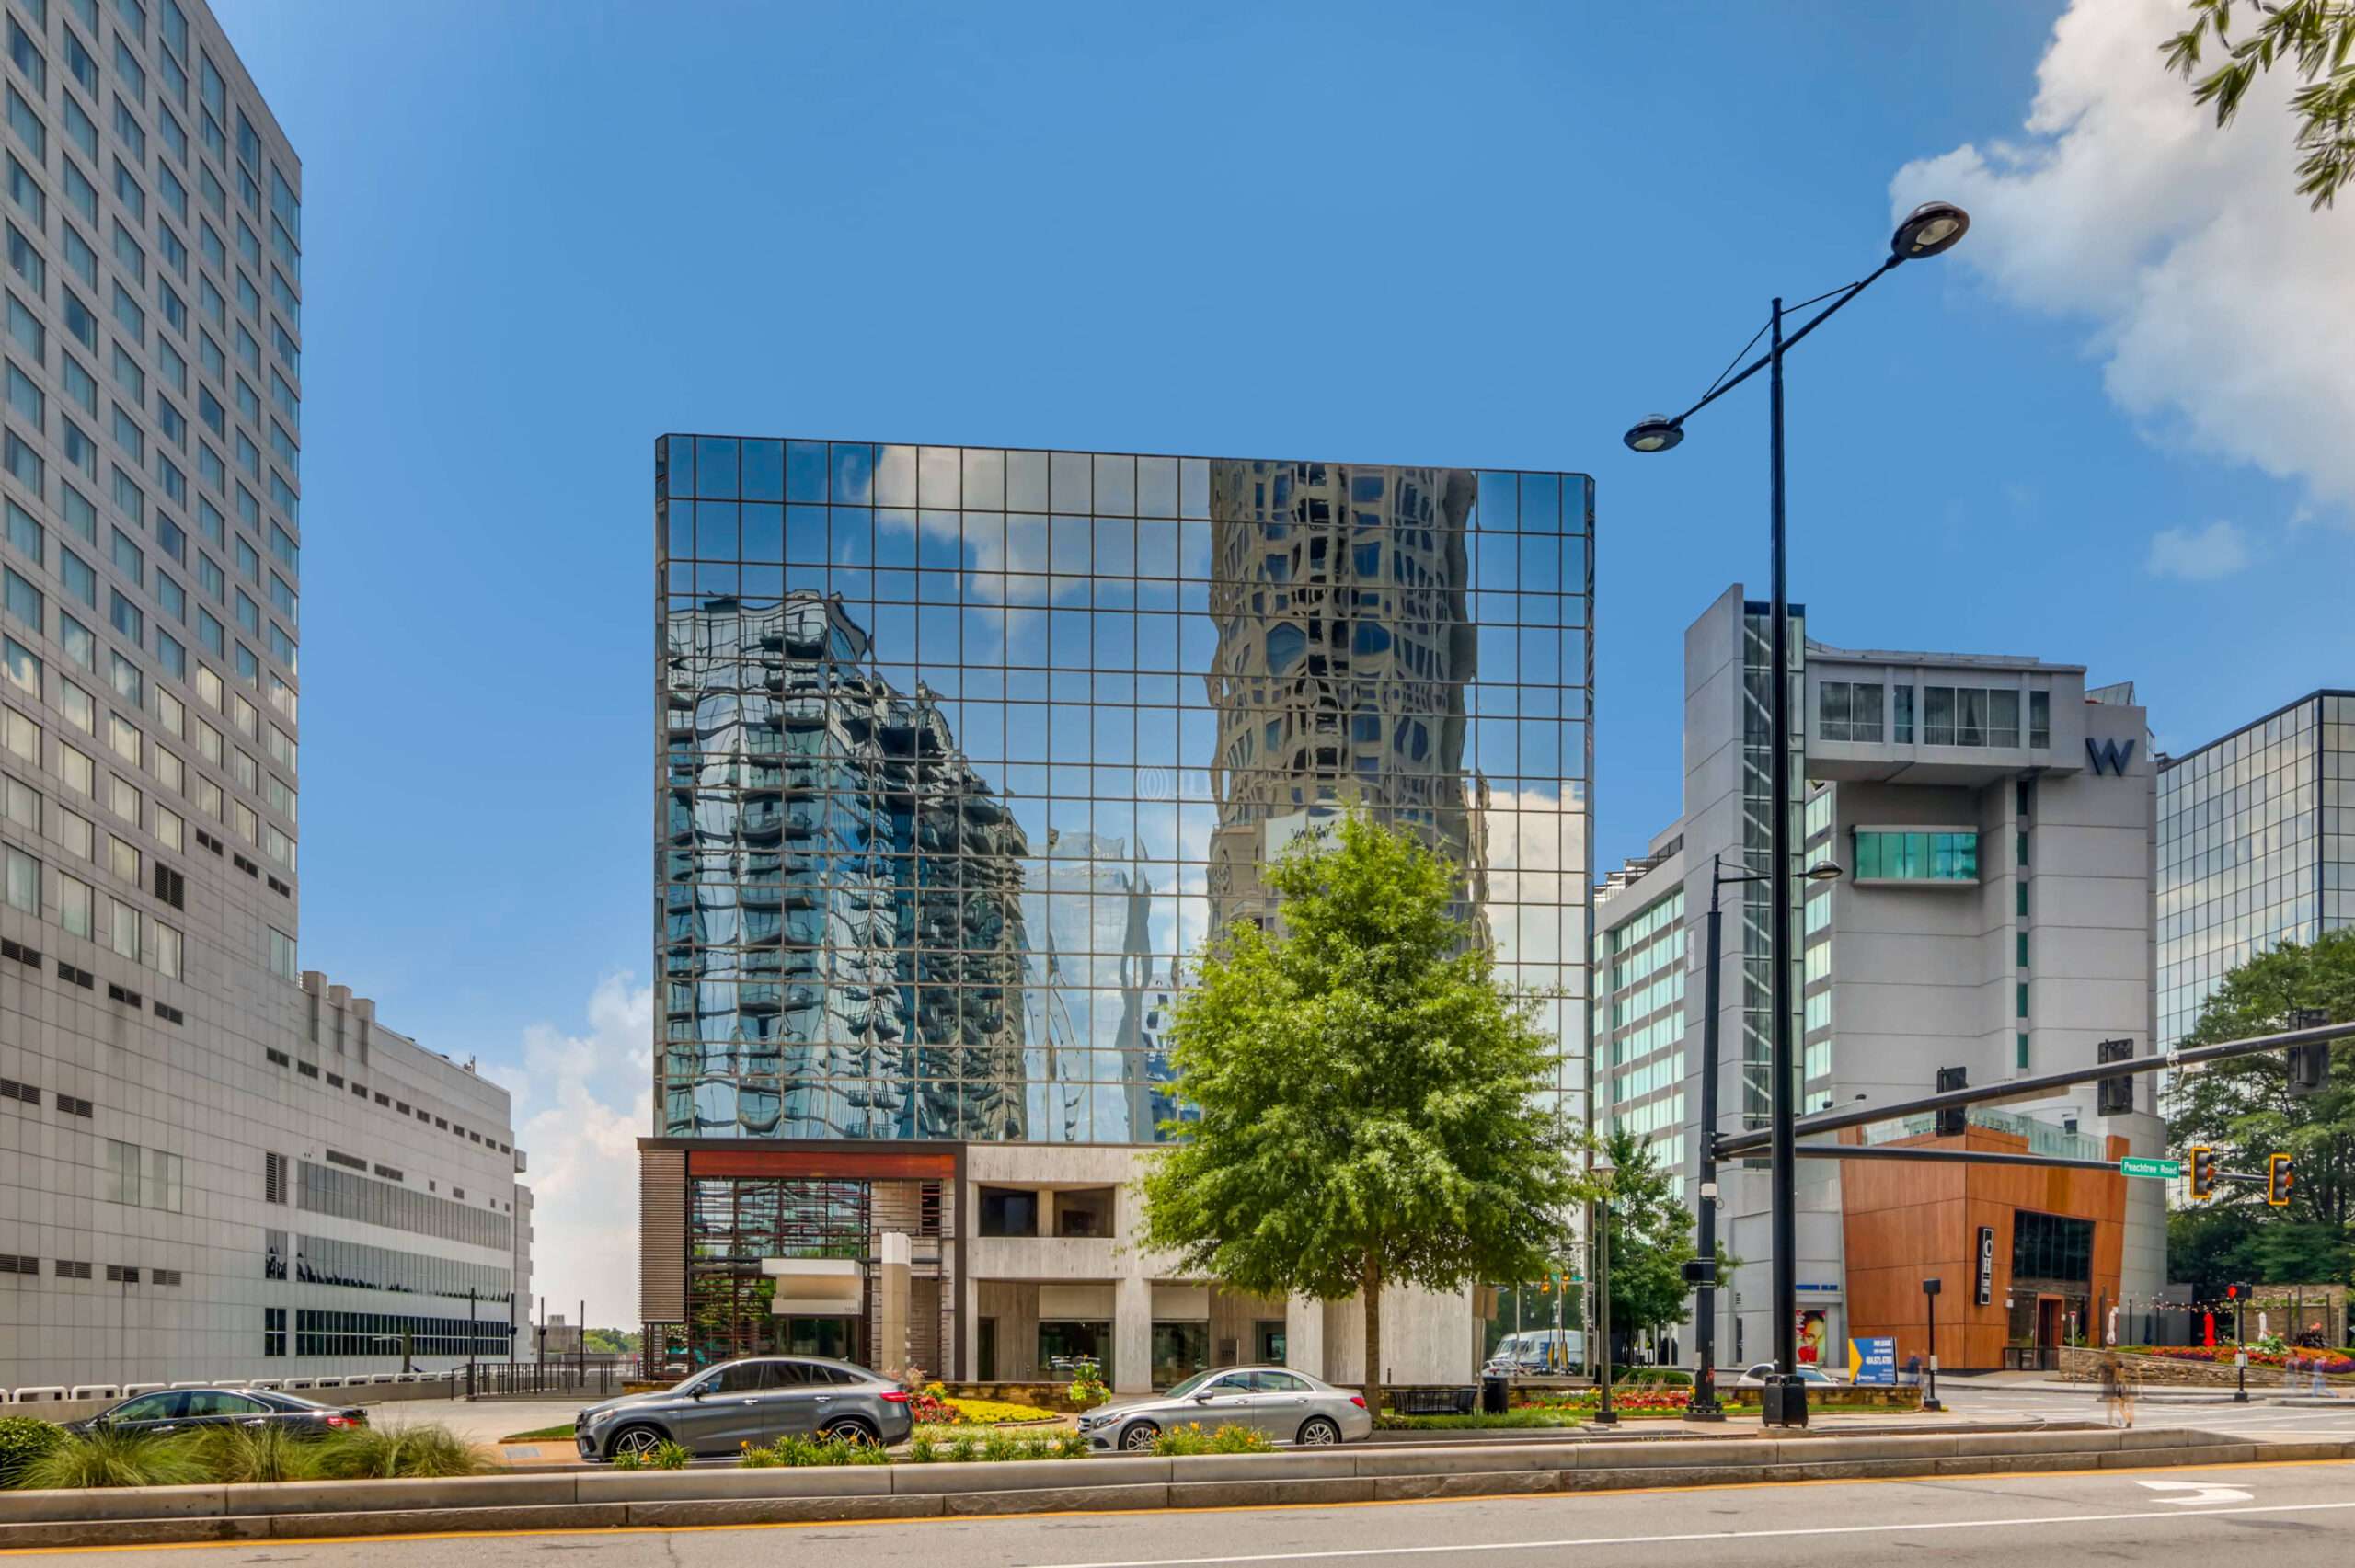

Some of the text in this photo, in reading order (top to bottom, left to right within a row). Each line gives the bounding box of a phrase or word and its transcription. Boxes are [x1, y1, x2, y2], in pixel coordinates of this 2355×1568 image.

[2085, 738, 2135, 776] W
[2124, 1162, 2177, 1175] Peachtree Road
